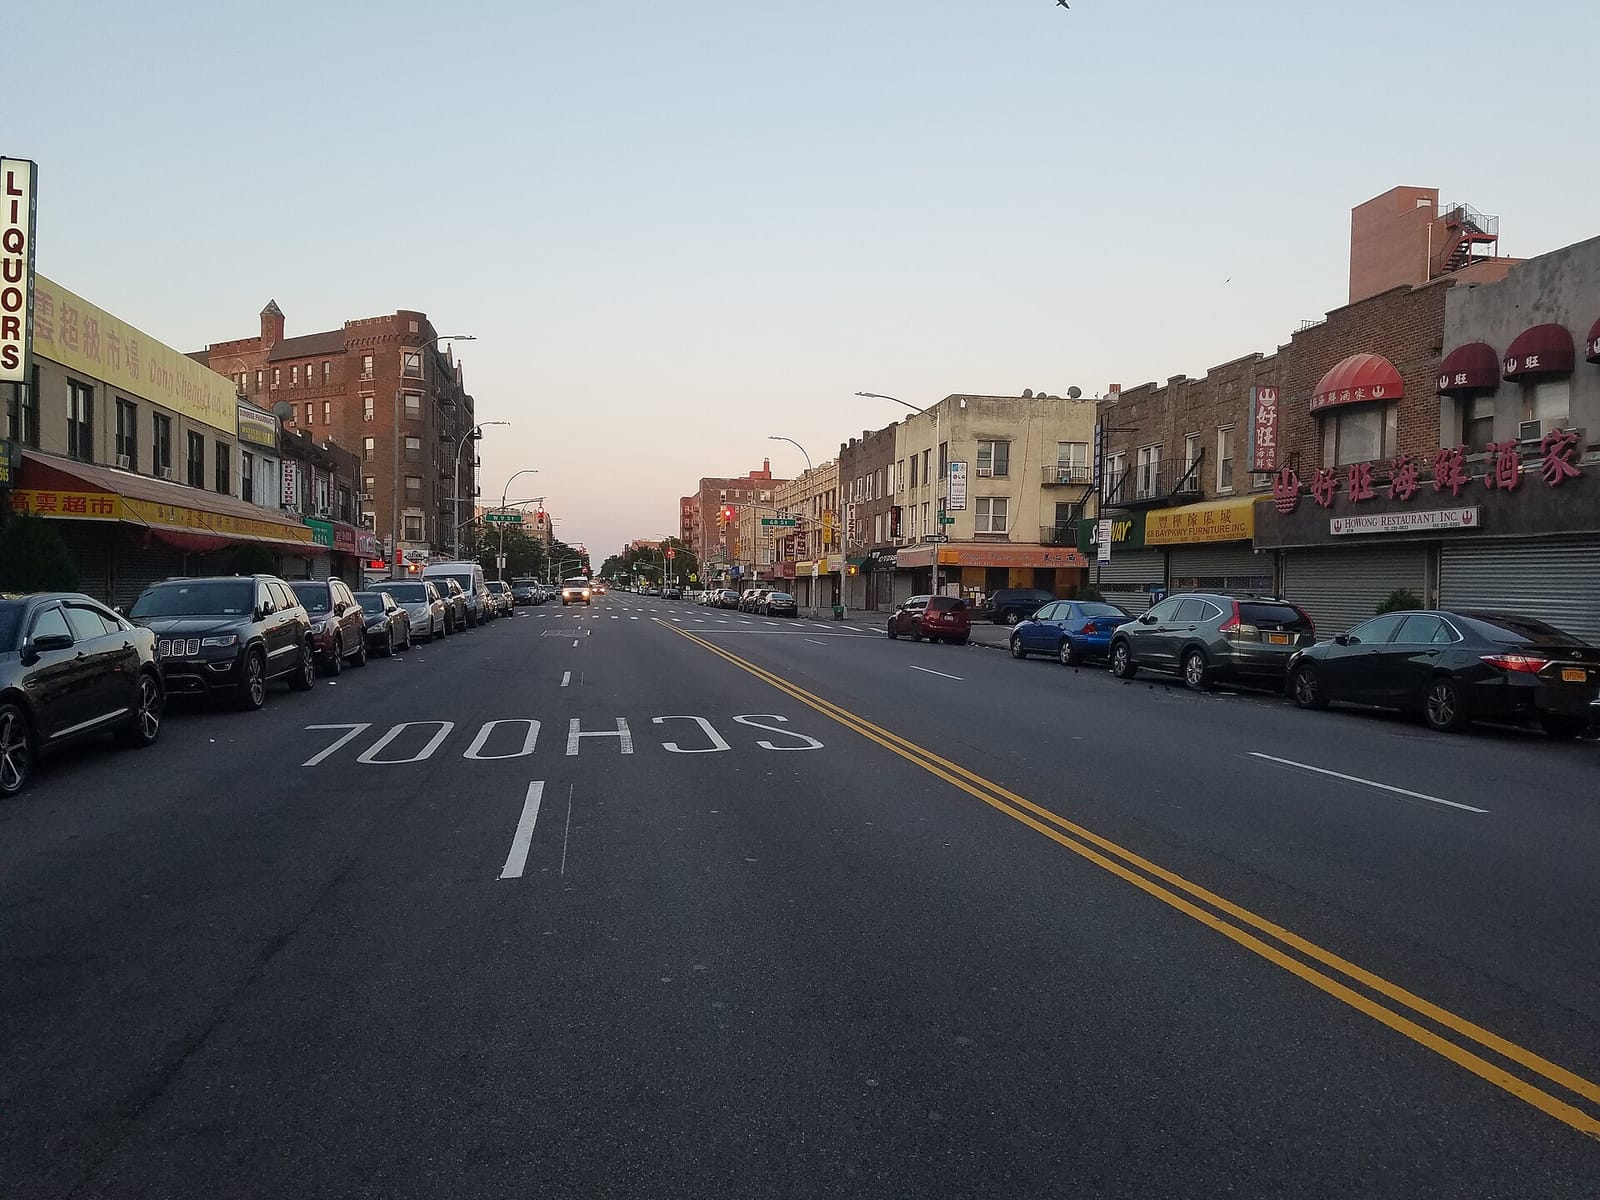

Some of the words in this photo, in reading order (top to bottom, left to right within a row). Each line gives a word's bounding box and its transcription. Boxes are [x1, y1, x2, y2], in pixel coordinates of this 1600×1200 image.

[1, 171, 25, 370] LIQUORS
[27, 197, 36, 351] DISCOUNT
[1256, 405, 1277, 448] 好旺
[1310, 428, 1582, 508] 好旺海鮮酒家
[1089, 520, 1132, 544] SWAY
[1155, 527, 1187, 537] BAYPKWY
[1188, 524, 1230, 536] FURNITURE
[1231, 522, 1248, 532] INC.
[1381, 512, 1436, 527] RESTAURANT
[1440, 511, 1458, 522] INC.
[301, 714, 824, 766] SCHOOL
